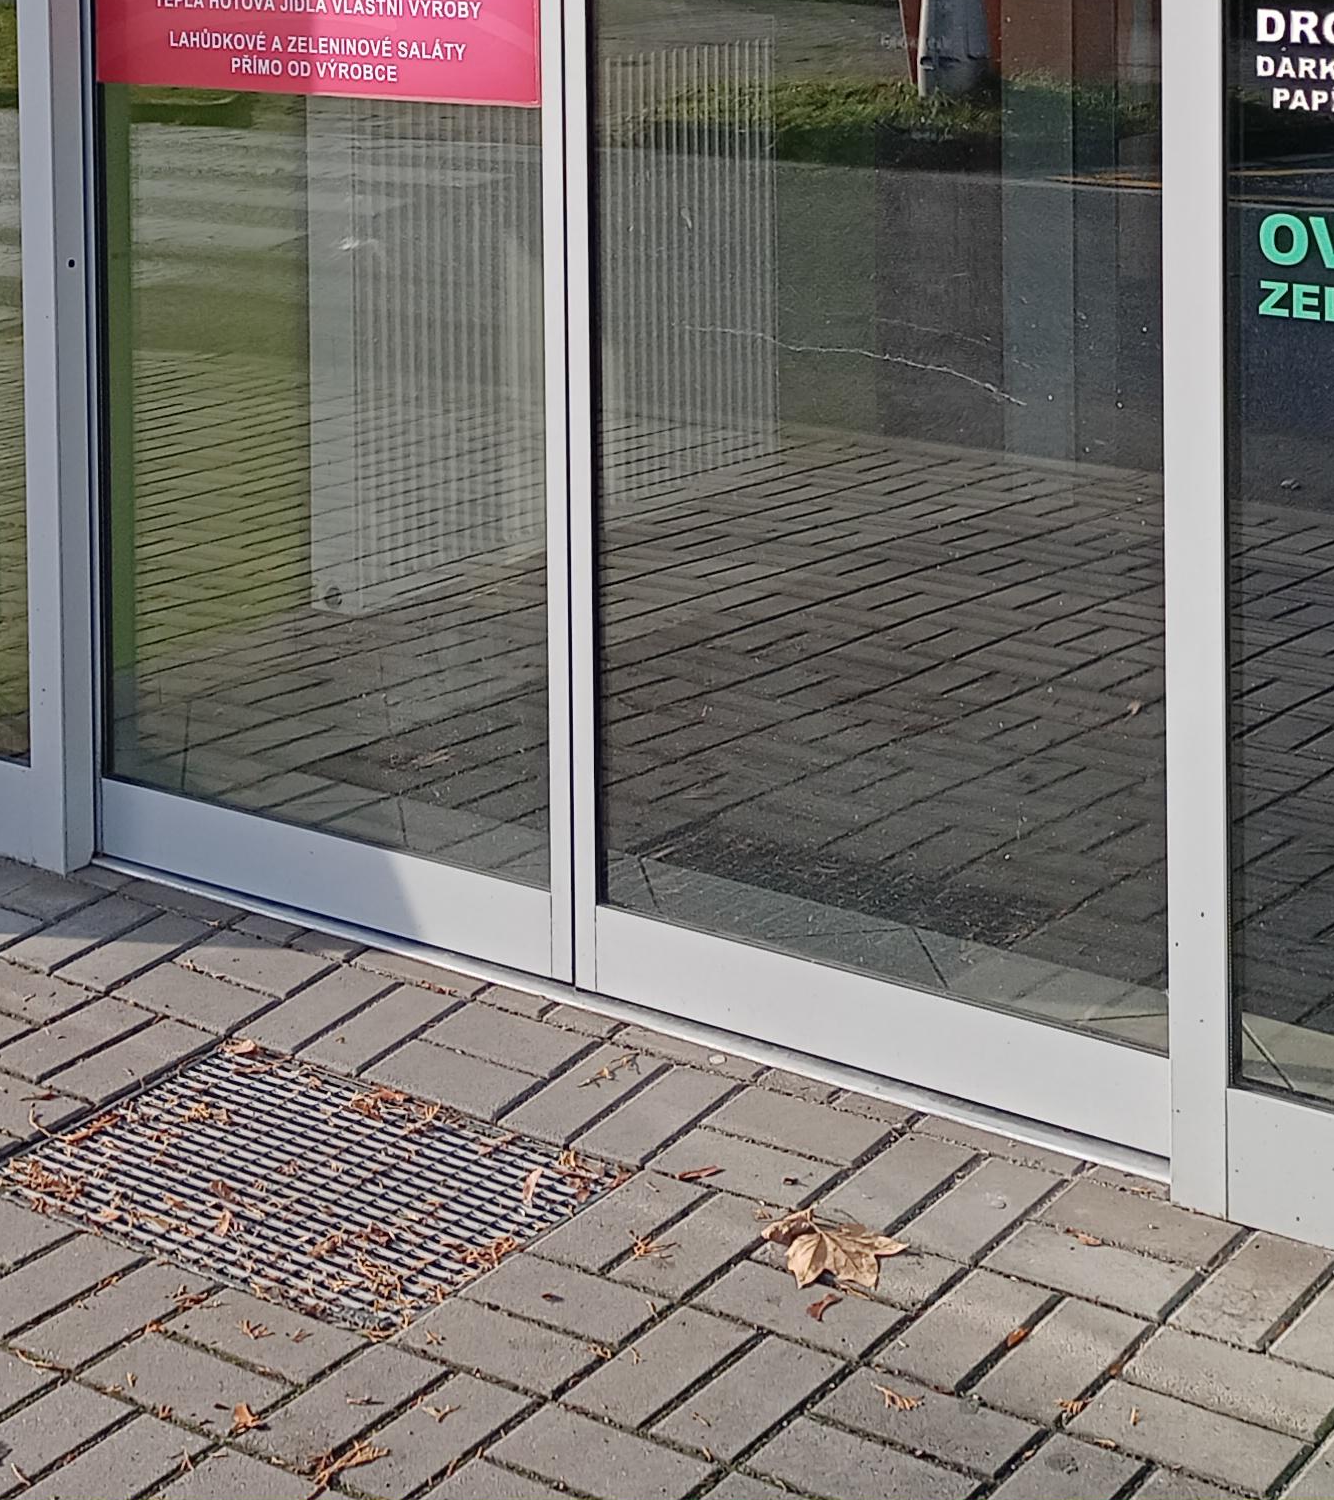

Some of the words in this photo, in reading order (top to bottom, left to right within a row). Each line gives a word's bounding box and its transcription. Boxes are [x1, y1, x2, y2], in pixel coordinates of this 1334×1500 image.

[170, 29, 267, 51] LAHŮDKOVÉ
[271, 35, 283, 52] A
[287, 35, 393, 58] ZELENINOVÉ
[397, 39, 467, 61] SALÁTY
[231, 54, 283, 76] PŘÍMO
[288, 60, 311, 77] OD
[316, 59, 398, 82] VÝROBCE
